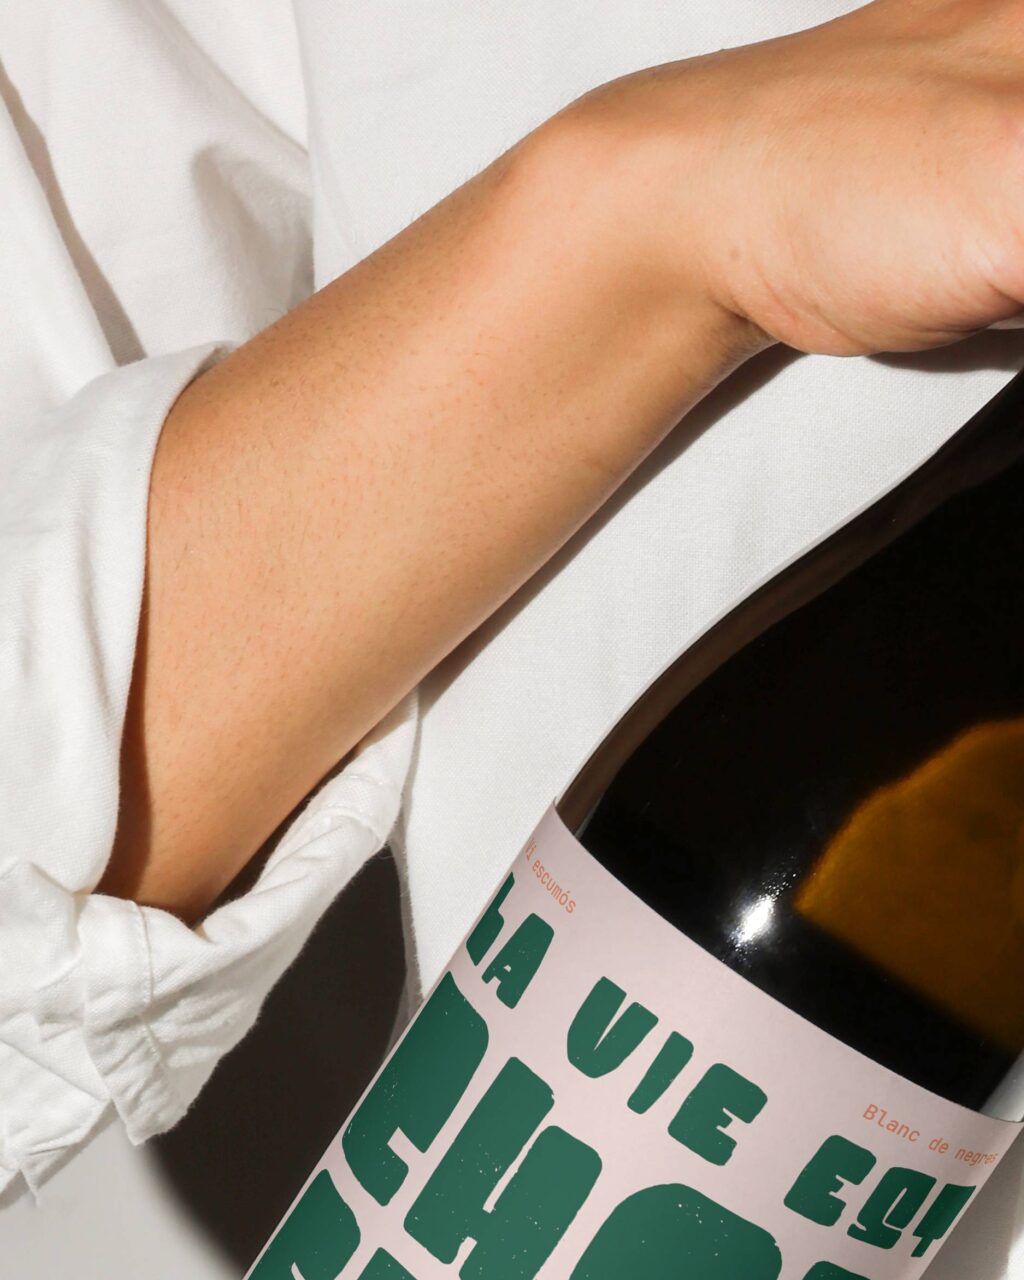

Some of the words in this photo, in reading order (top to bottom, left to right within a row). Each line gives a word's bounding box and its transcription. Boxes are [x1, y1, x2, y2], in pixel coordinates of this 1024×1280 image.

[532, 858, 577, 914] escumós
[467, 874, 554, 1009] LA
[568, 977, 768, 1166] VIE
[784, 1135, 976, 1257] EST
[862, 1103, 921, 1142] Blanc
[927, 1137, 955, 1154] de
